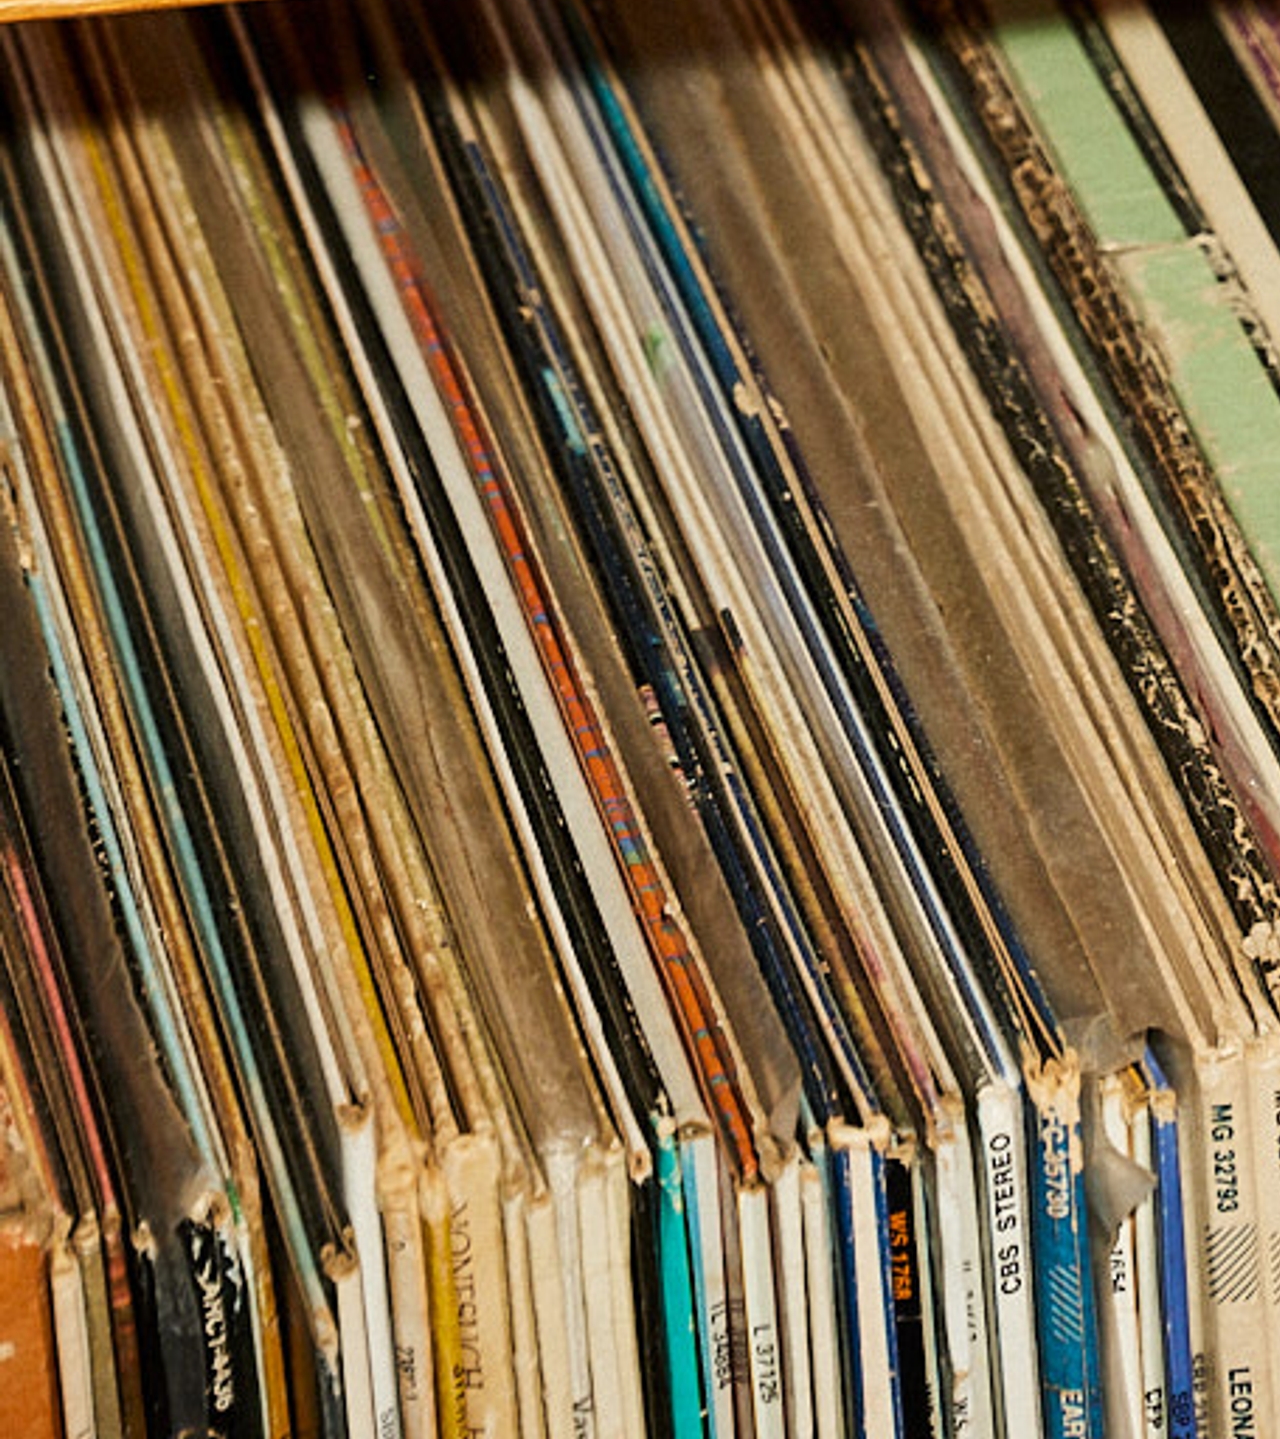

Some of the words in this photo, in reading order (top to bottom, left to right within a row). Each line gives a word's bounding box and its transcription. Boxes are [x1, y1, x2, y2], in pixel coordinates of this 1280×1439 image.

[1212, 1104, 1235, 1141] MG
[990, 1135, 1020, 1232] STEREO
[1213, 1151, 1239, 1212] 32793
[888, 1211, 909, 1247] WS
[890, 1252, 912, 1299] 1768
[997, 1246, 1022, 1294] CBS
[756, 1344, 779, 1404] 37125
